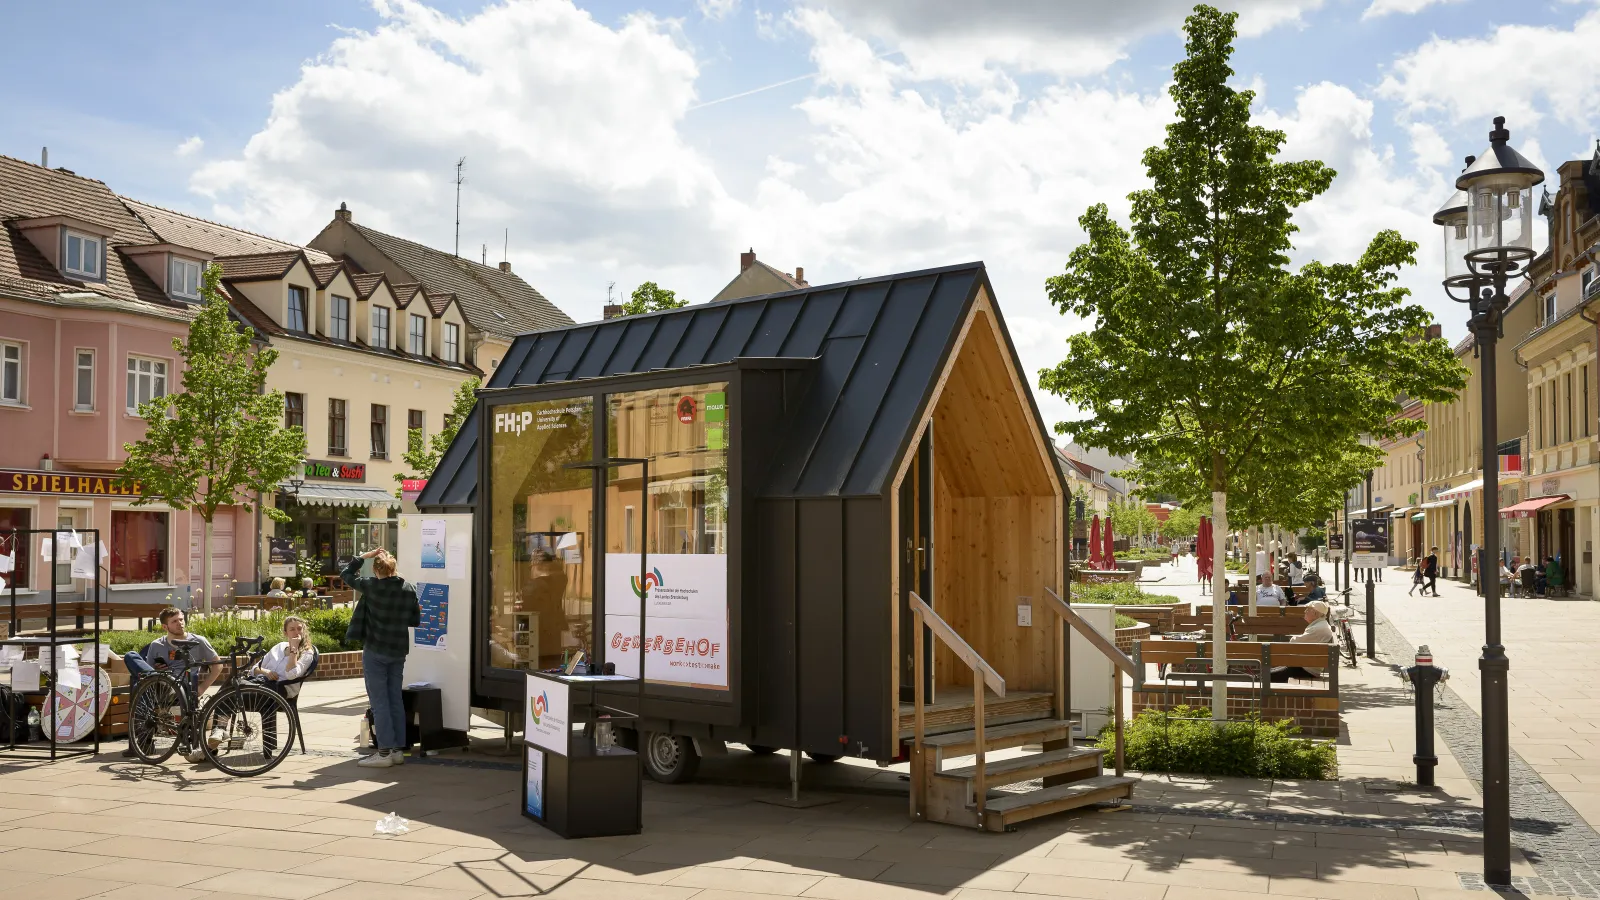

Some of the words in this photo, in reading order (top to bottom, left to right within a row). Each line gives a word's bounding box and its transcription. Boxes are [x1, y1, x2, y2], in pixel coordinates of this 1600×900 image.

[315, 462, 330, 477] Tea
[332, 467, 340, 478] &
[340, 464, 364, 480] Sushi
[12, 473, 142, 496] SPIELHALLE
[611, 631, 721, 659] GEWERBEHOF
